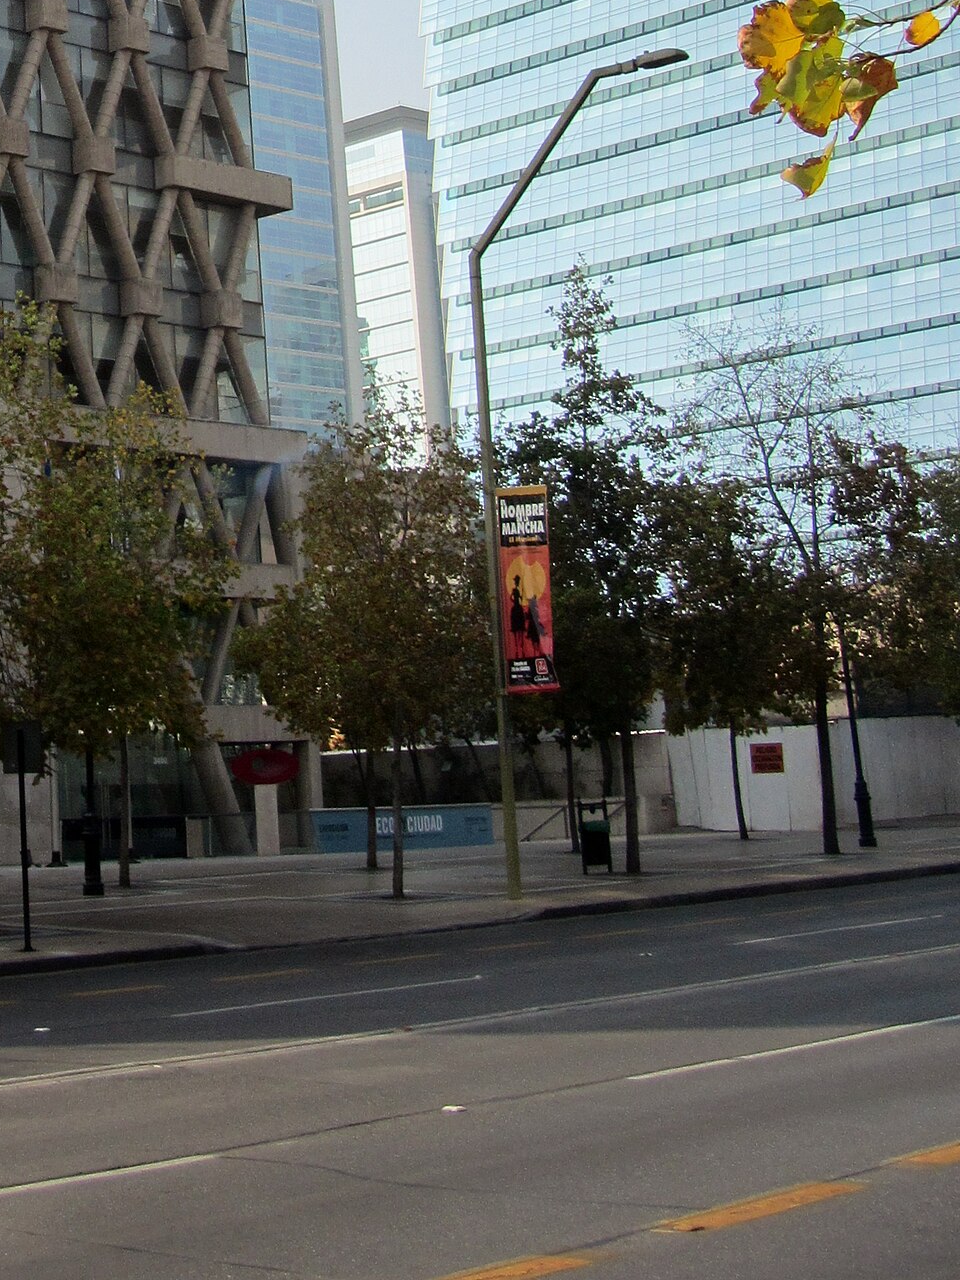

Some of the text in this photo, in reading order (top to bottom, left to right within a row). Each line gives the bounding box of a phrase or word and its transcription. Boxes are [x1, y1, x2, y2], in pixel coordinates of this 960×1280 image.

[500, 503, 545, 519] HOMBRE
[501, 520, 546, 536] MANCHA
[406, 814, 443, 833] CIUDAD
